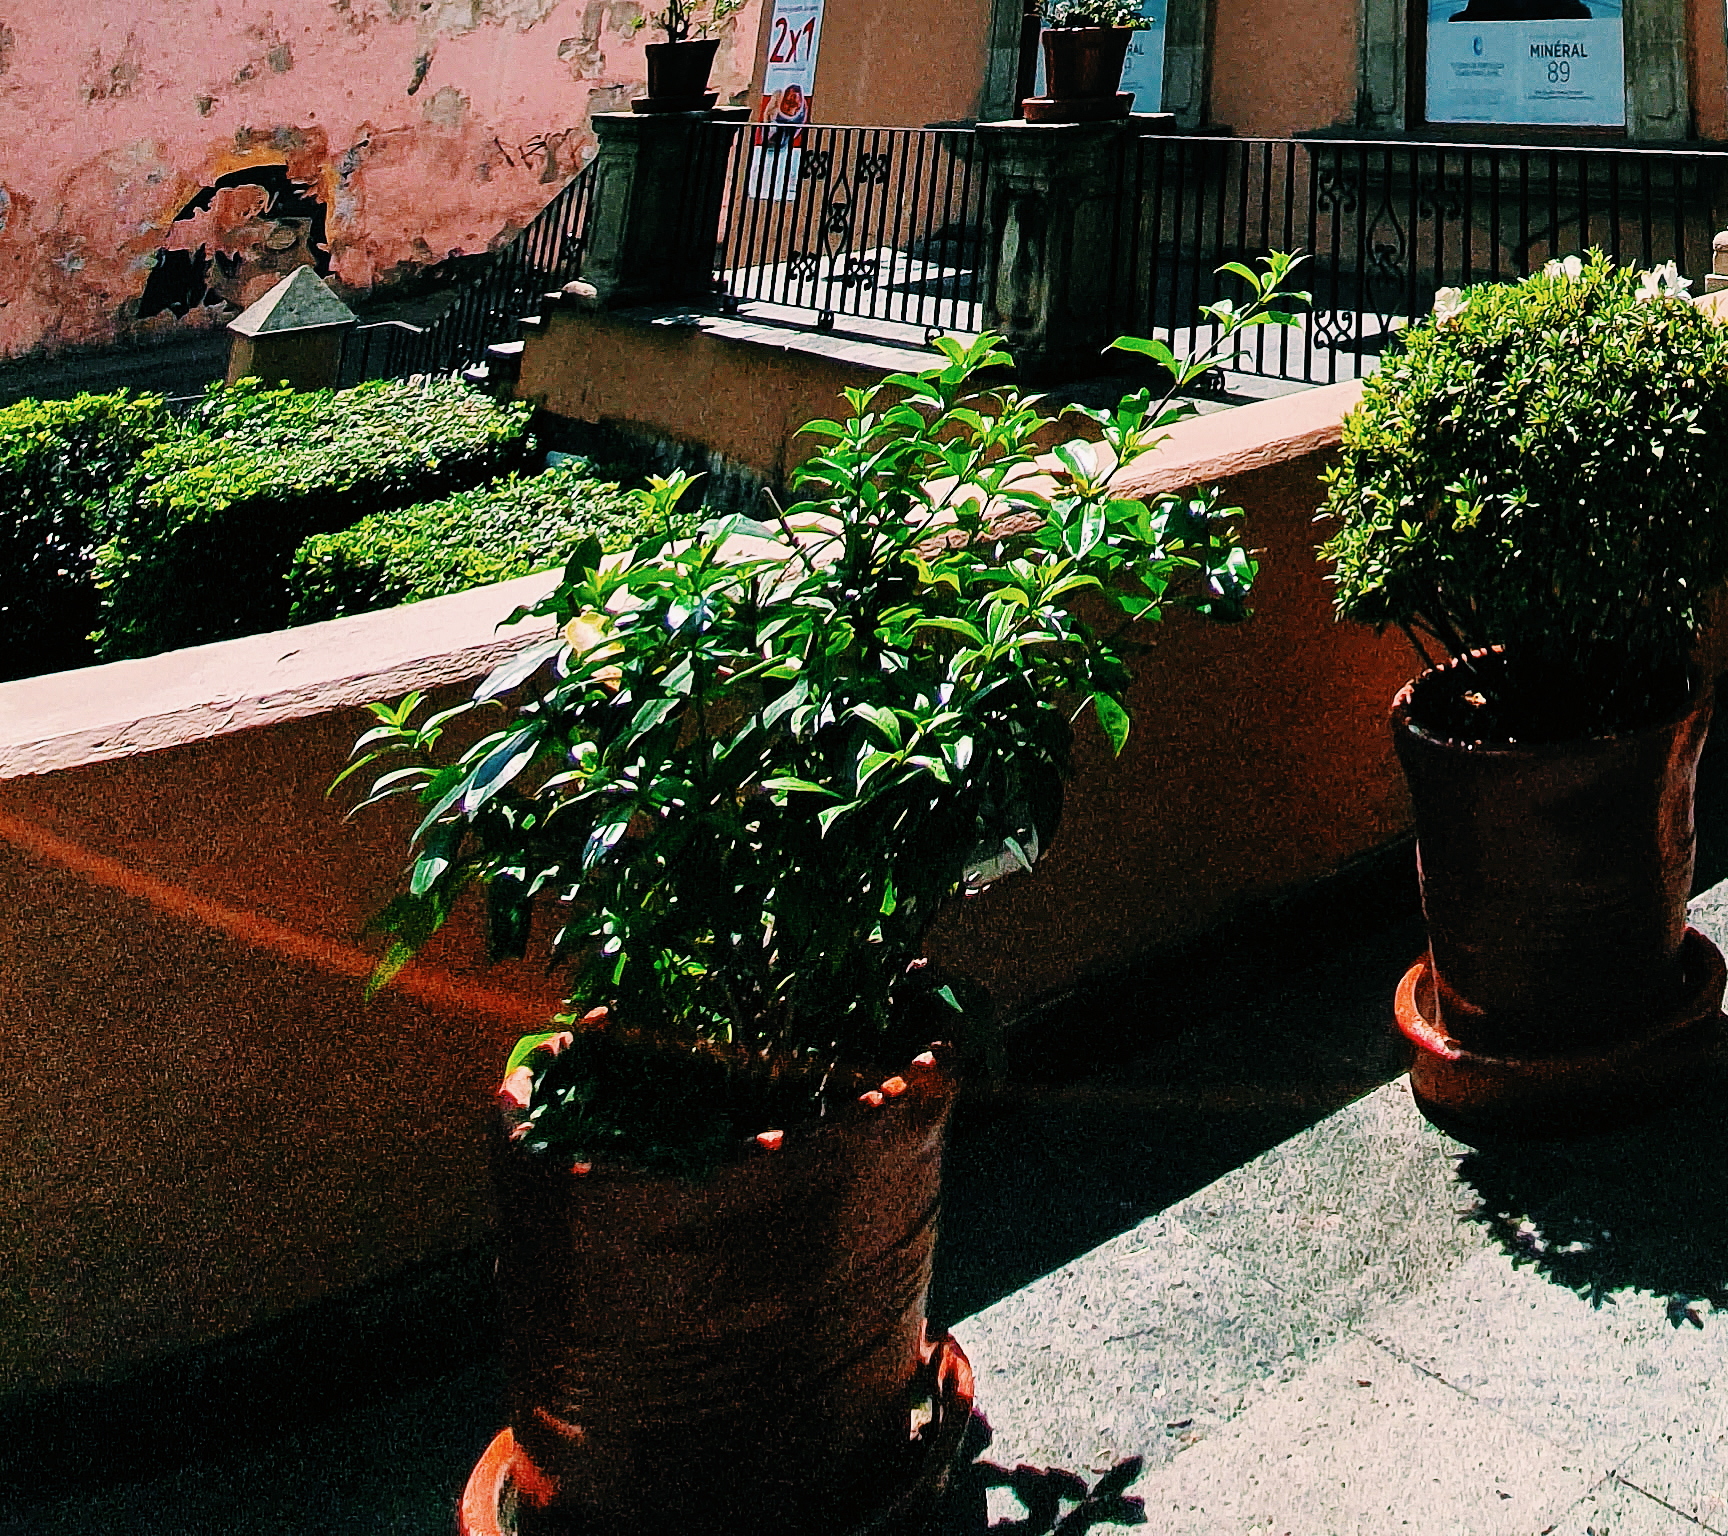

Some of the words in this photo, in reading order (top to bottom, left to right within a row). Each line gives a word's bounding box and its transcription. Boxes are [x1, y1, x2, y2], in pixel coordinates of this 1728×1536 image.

[770, 17, 816, 63] 2x1
[1530, 40, 1588, 58] MINÉRAL
[1548, 61, 1570, 83] 89
